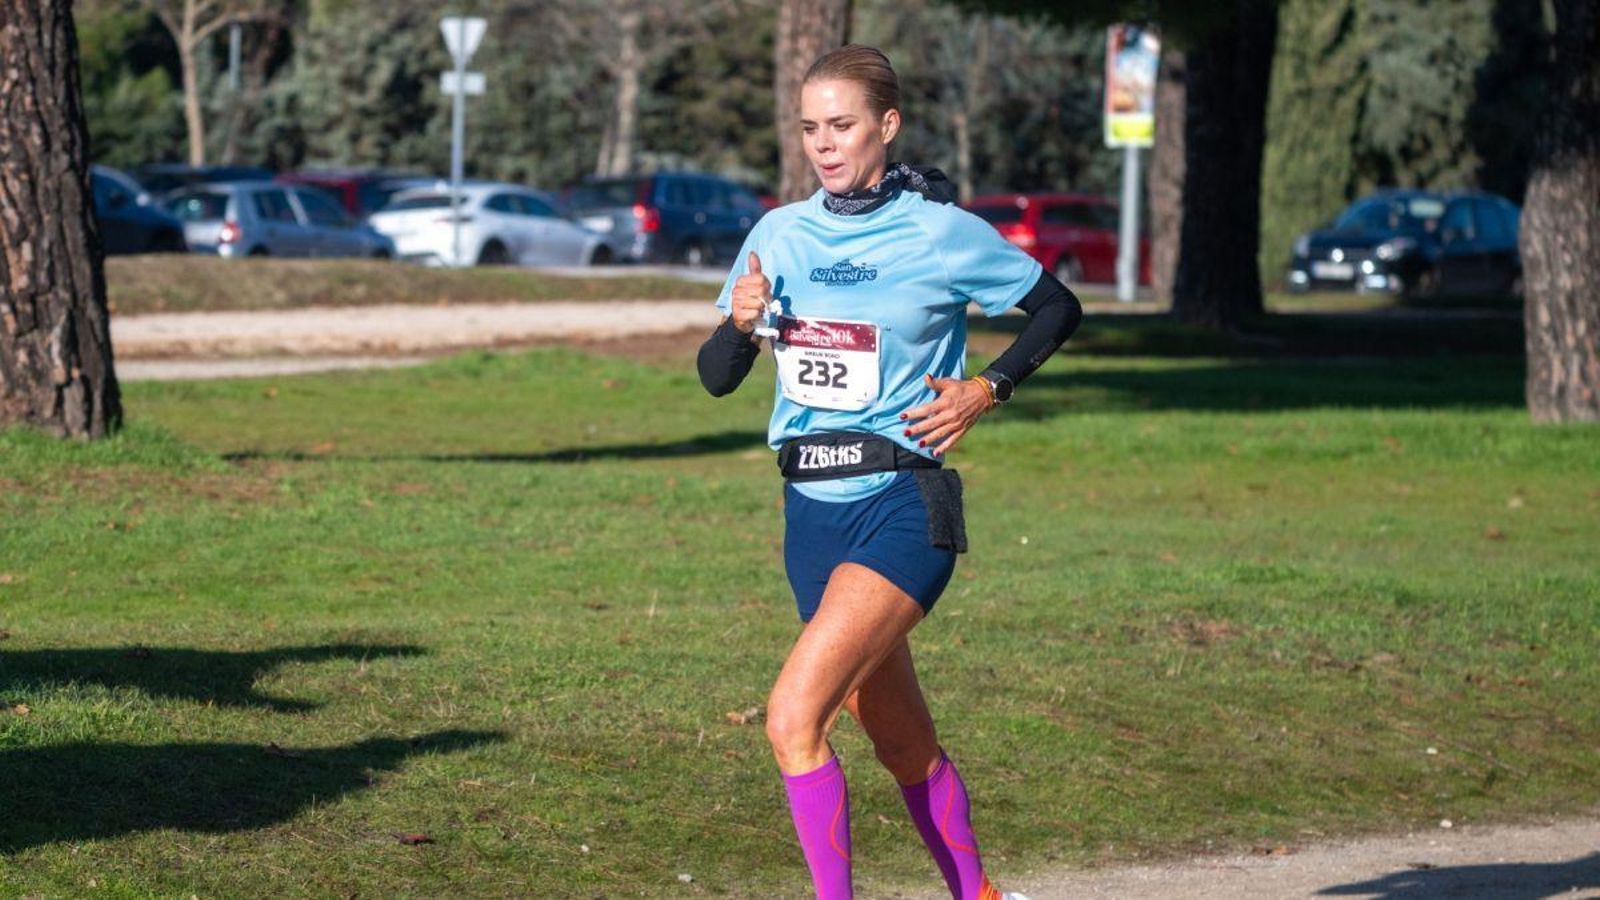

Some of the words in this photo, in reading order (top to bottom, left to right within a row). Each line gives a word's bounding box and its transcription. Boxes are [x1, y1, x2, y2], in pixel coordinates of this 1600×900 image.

[810, 267, 877, 282] Silvestre
[833, 329, 856, 345] 10k
[798, 359, 848, 389] 232
